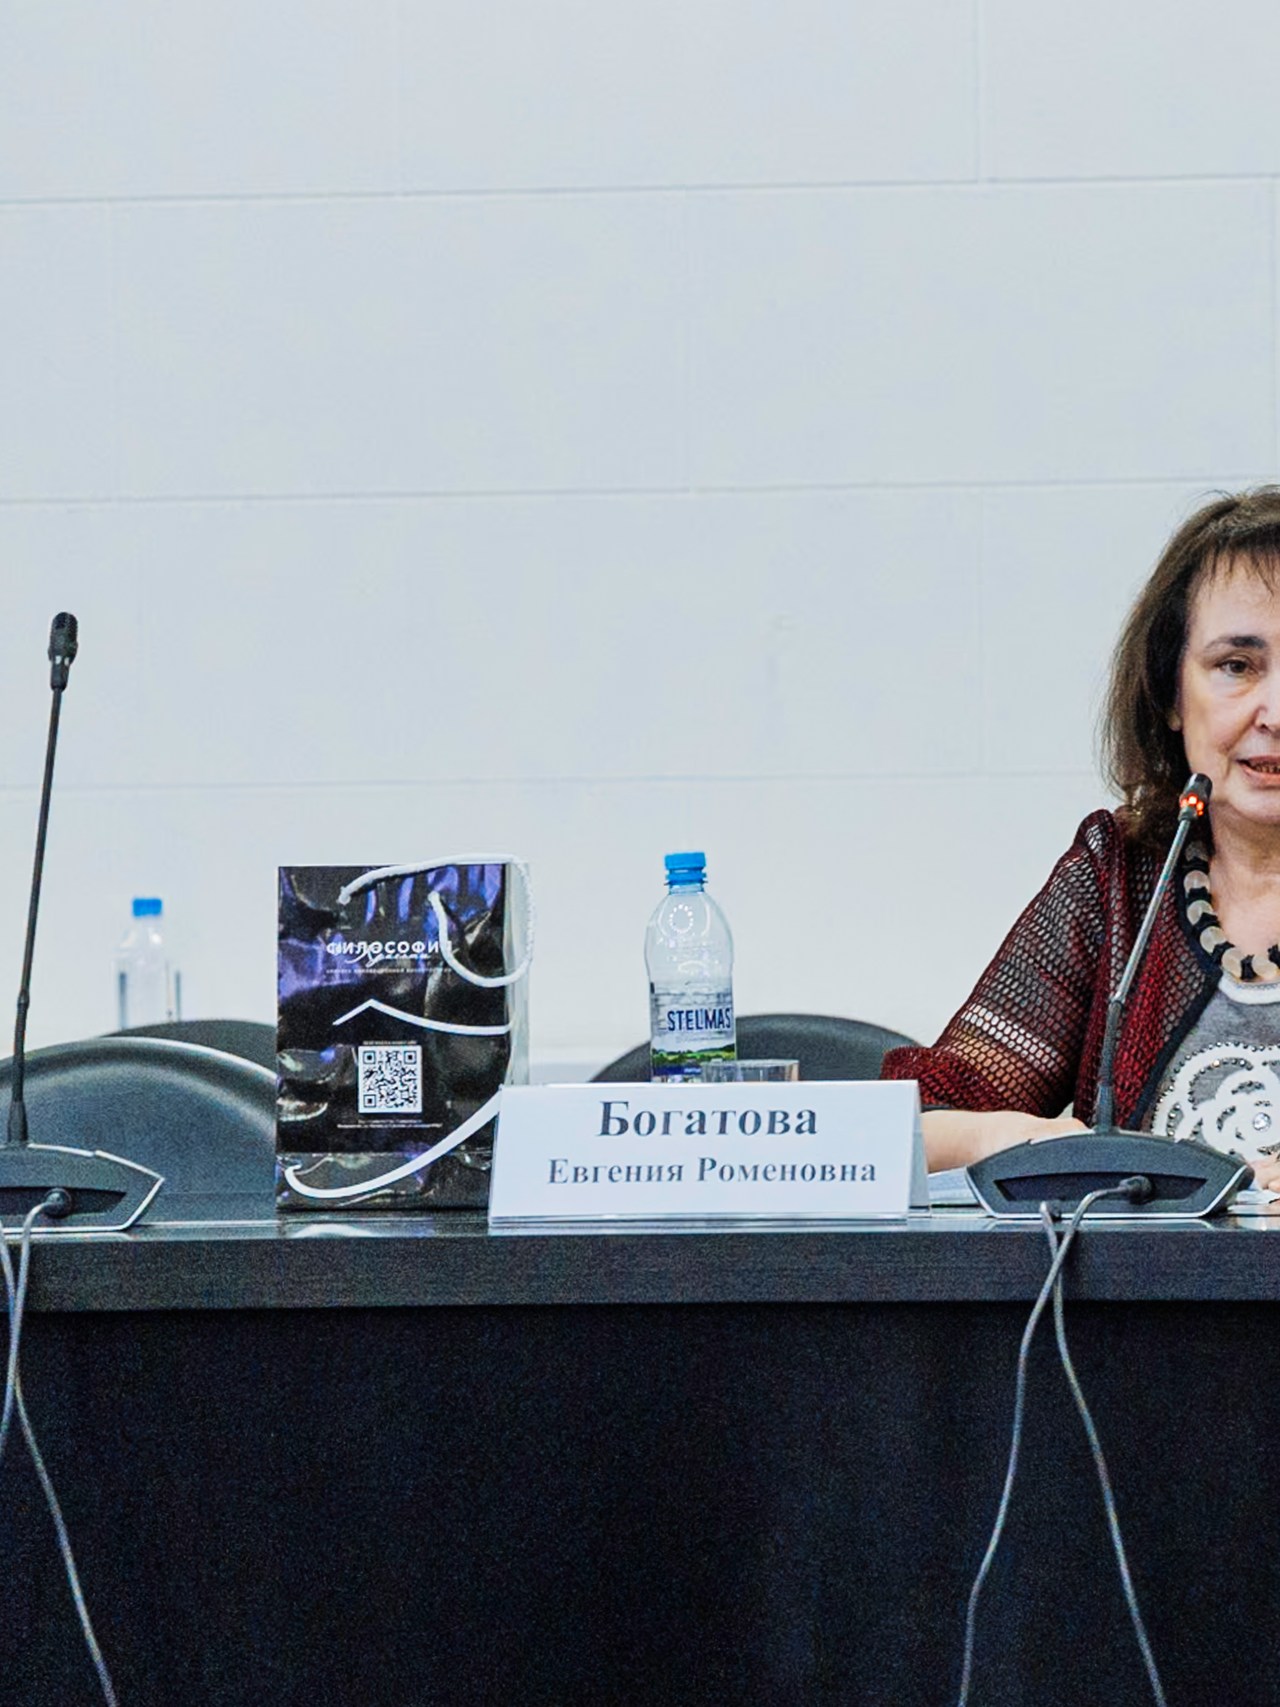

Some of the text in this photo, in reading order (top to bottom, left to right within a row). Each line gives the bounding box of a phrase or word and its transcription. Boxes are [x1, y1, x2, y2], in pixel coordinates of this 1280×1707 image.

[666, 1007, 732, 1031] STELMAS
[596, 1100, 818, 1137] Богатова
[547, 1157, 877, 1184] Евгения Роменовна
